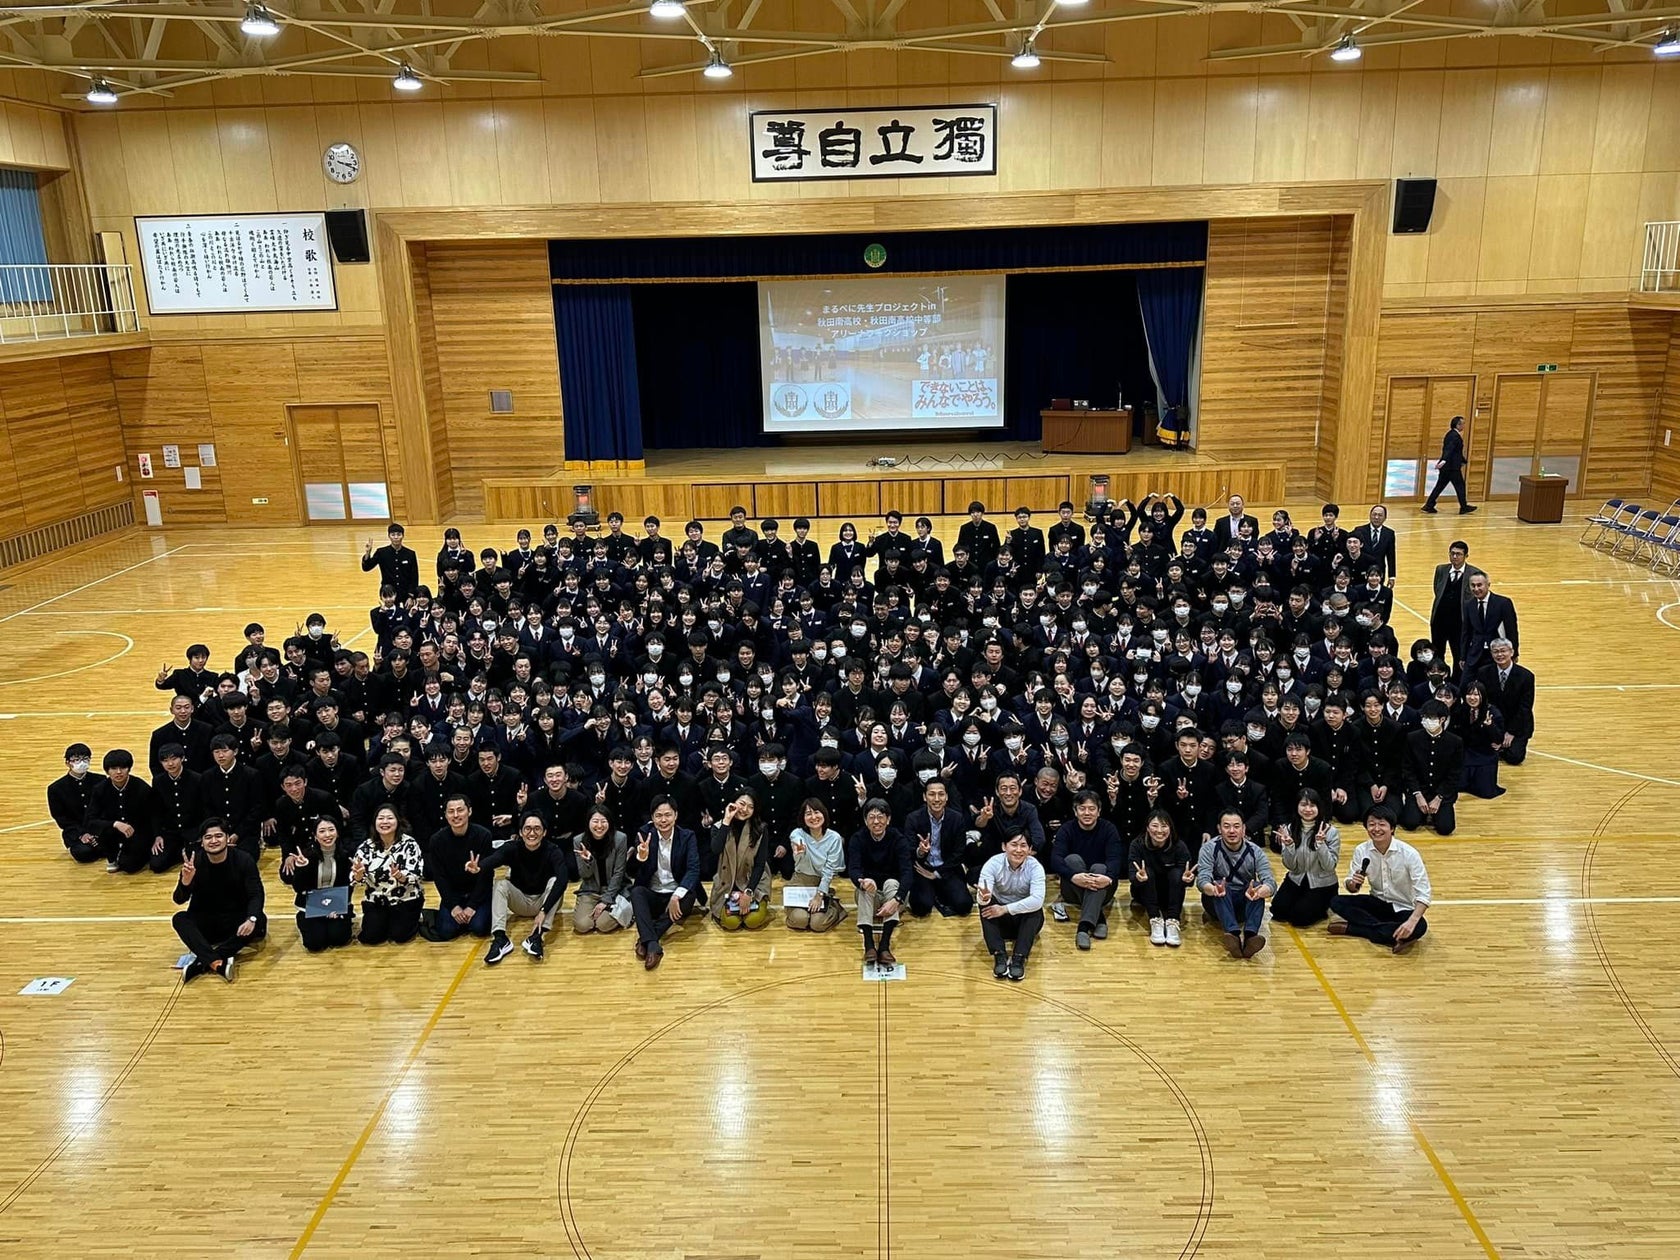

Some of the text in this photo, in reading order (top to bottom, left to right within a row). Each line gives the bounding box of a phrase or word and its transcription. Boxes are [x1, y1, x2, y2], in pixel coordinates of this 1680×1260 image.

[303, 229, 317, 262] 校歌
[920, 380, 992, 393] できないことは、
[915, 393, 996, 410] みんなでやろう。
